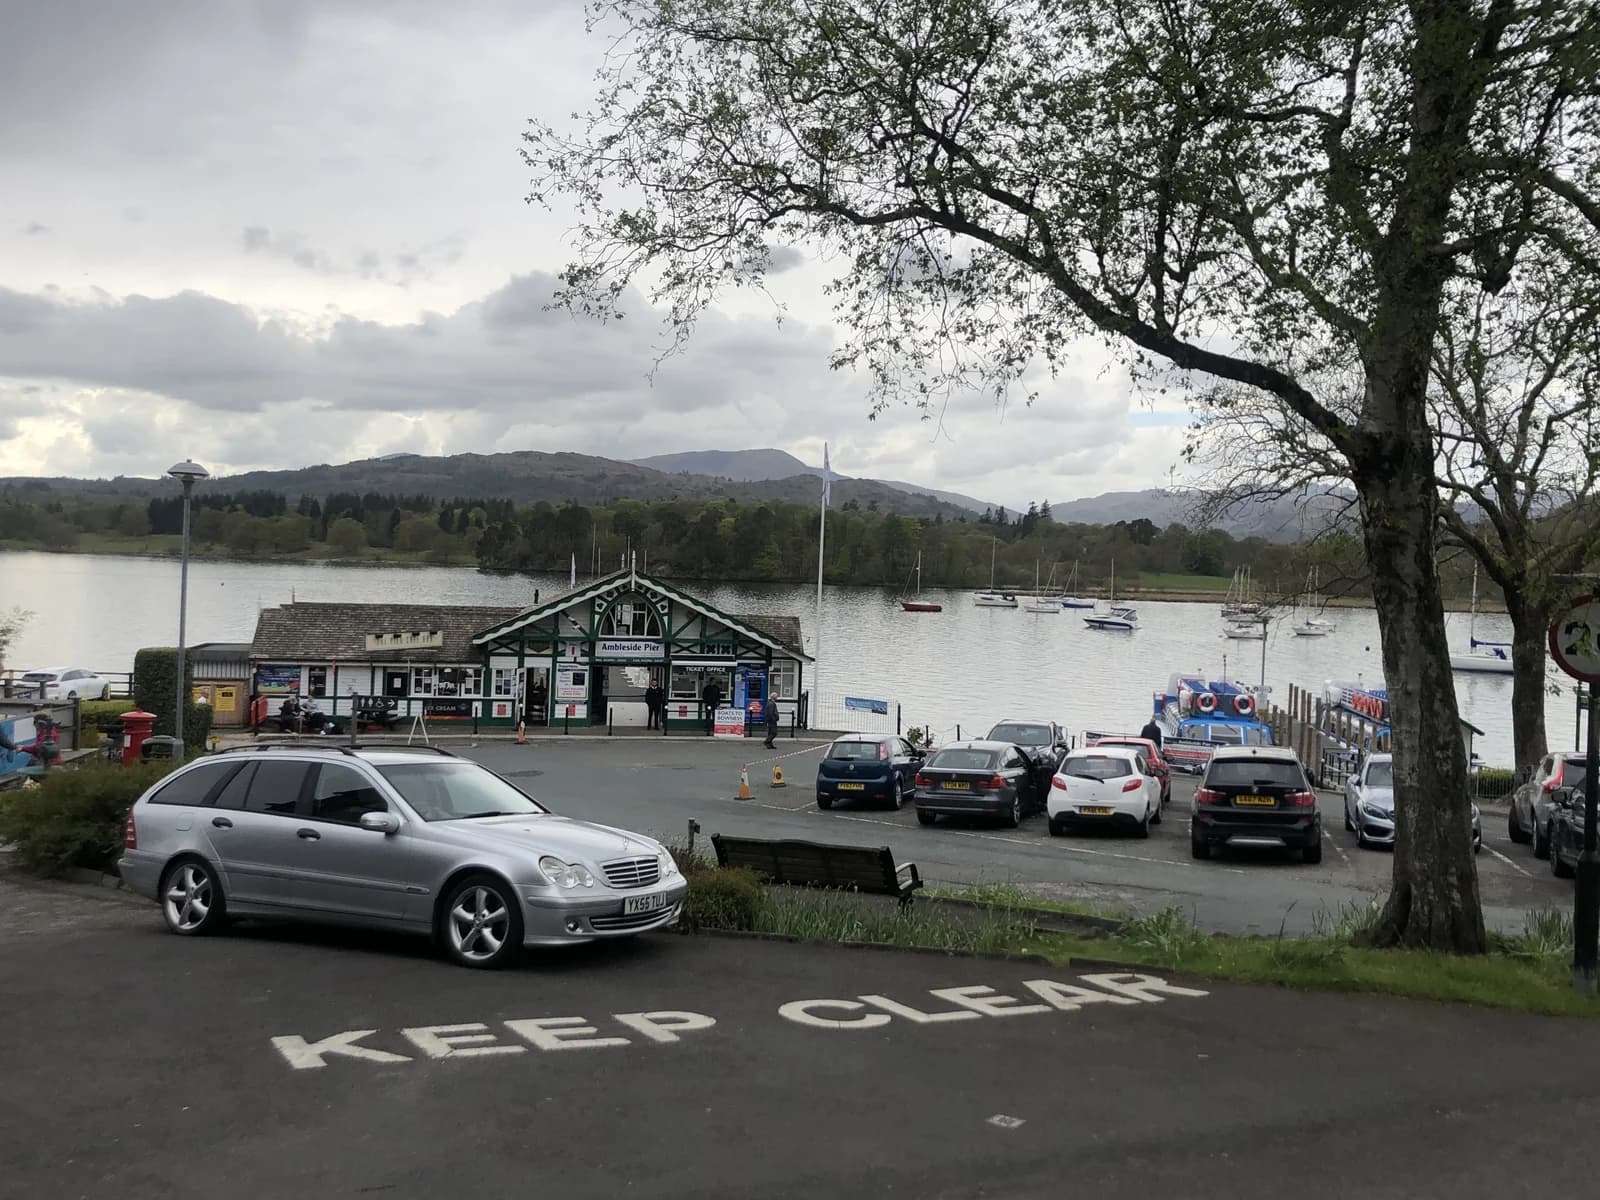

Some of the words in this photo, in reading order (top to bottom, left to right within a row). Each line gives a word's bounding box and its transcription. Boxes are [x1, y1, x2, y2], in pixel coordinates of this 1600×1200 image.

[601, 643, 642, 651] Ambleside
[644, 643, 660, 652] Pier
[1564, 620, 1600, 656] 2
[628, 895, 651, 913] YX55
[270, 1010, 717, 1069] KEEP
[778, 972, 1211, 1028] CLEAR
